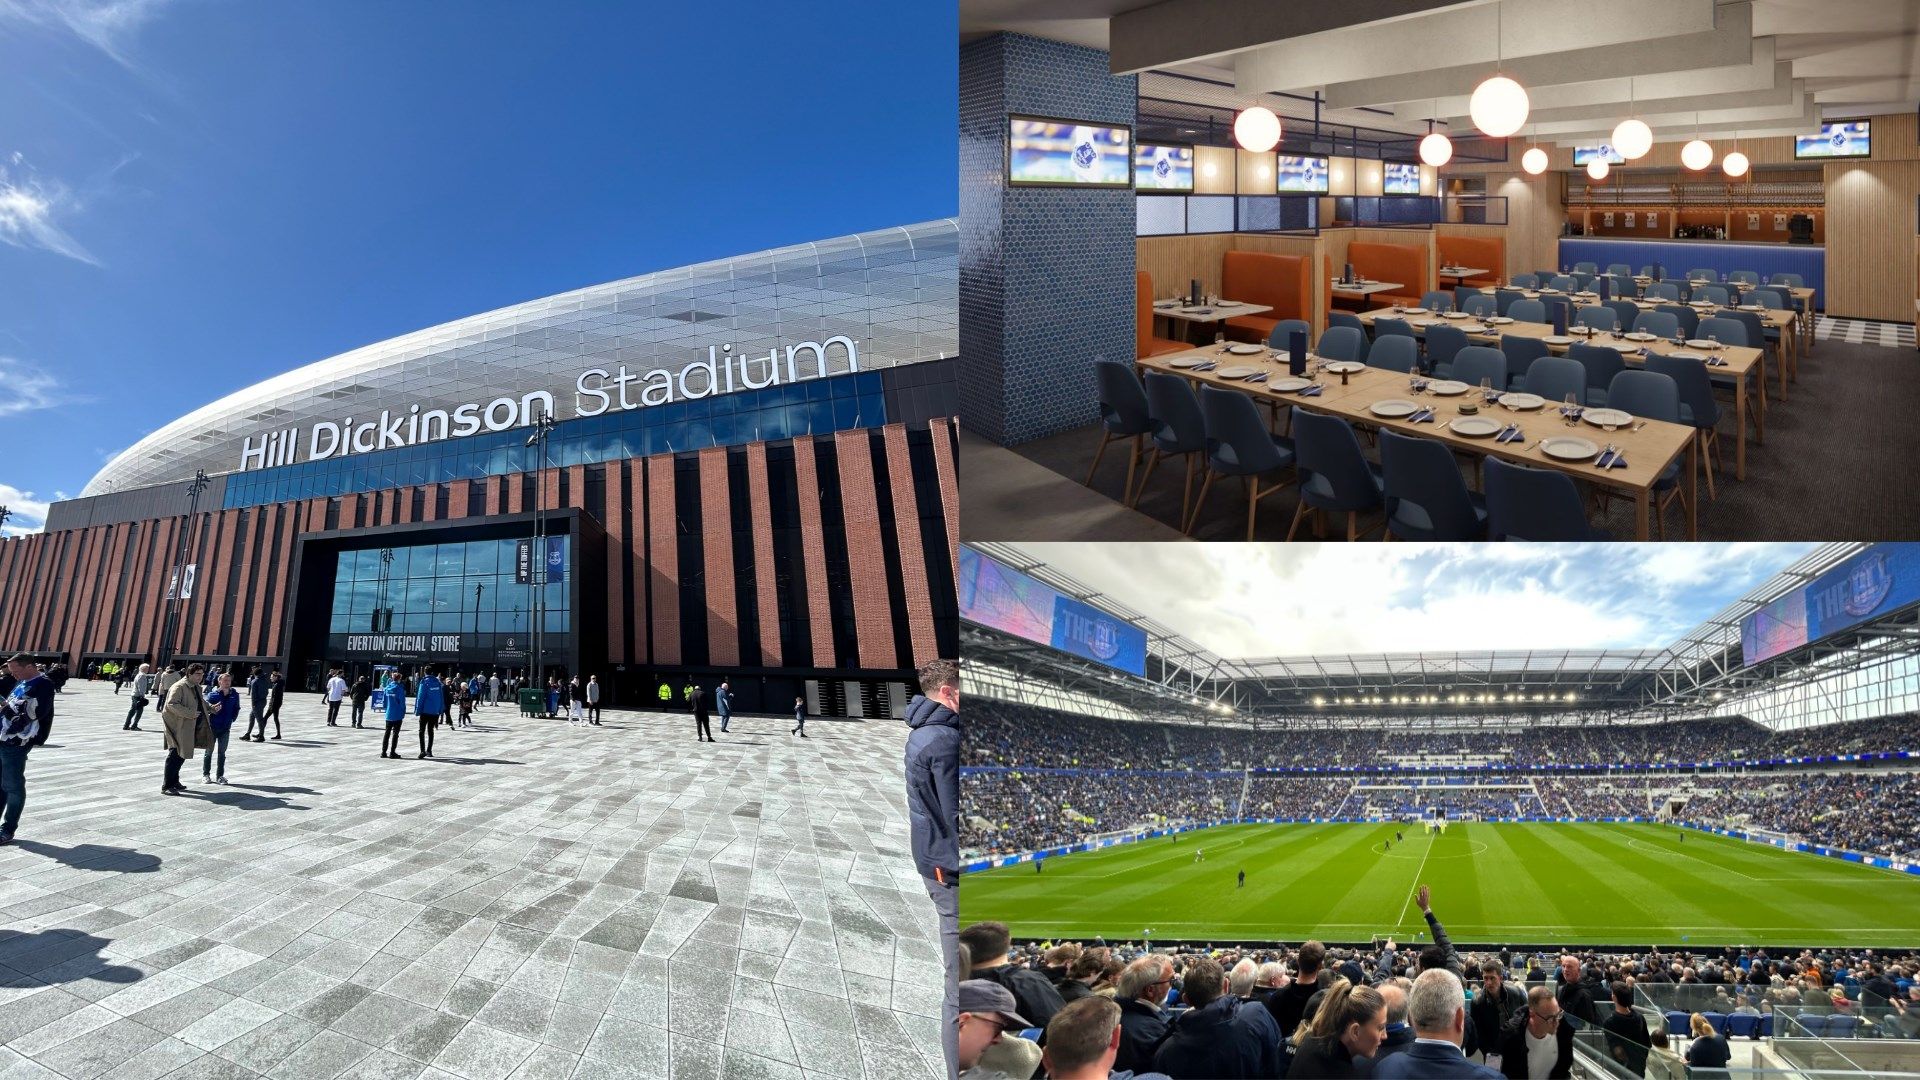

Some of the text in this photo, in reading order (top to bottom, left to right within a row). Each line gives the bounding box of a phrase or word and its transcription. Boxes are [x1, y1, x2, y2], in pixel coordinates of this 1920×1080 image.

[240, 334, 860, 471] Hill Dickinson Stadium
[347, 635, 460, 652] EVERTON OFFICIAL STORE
